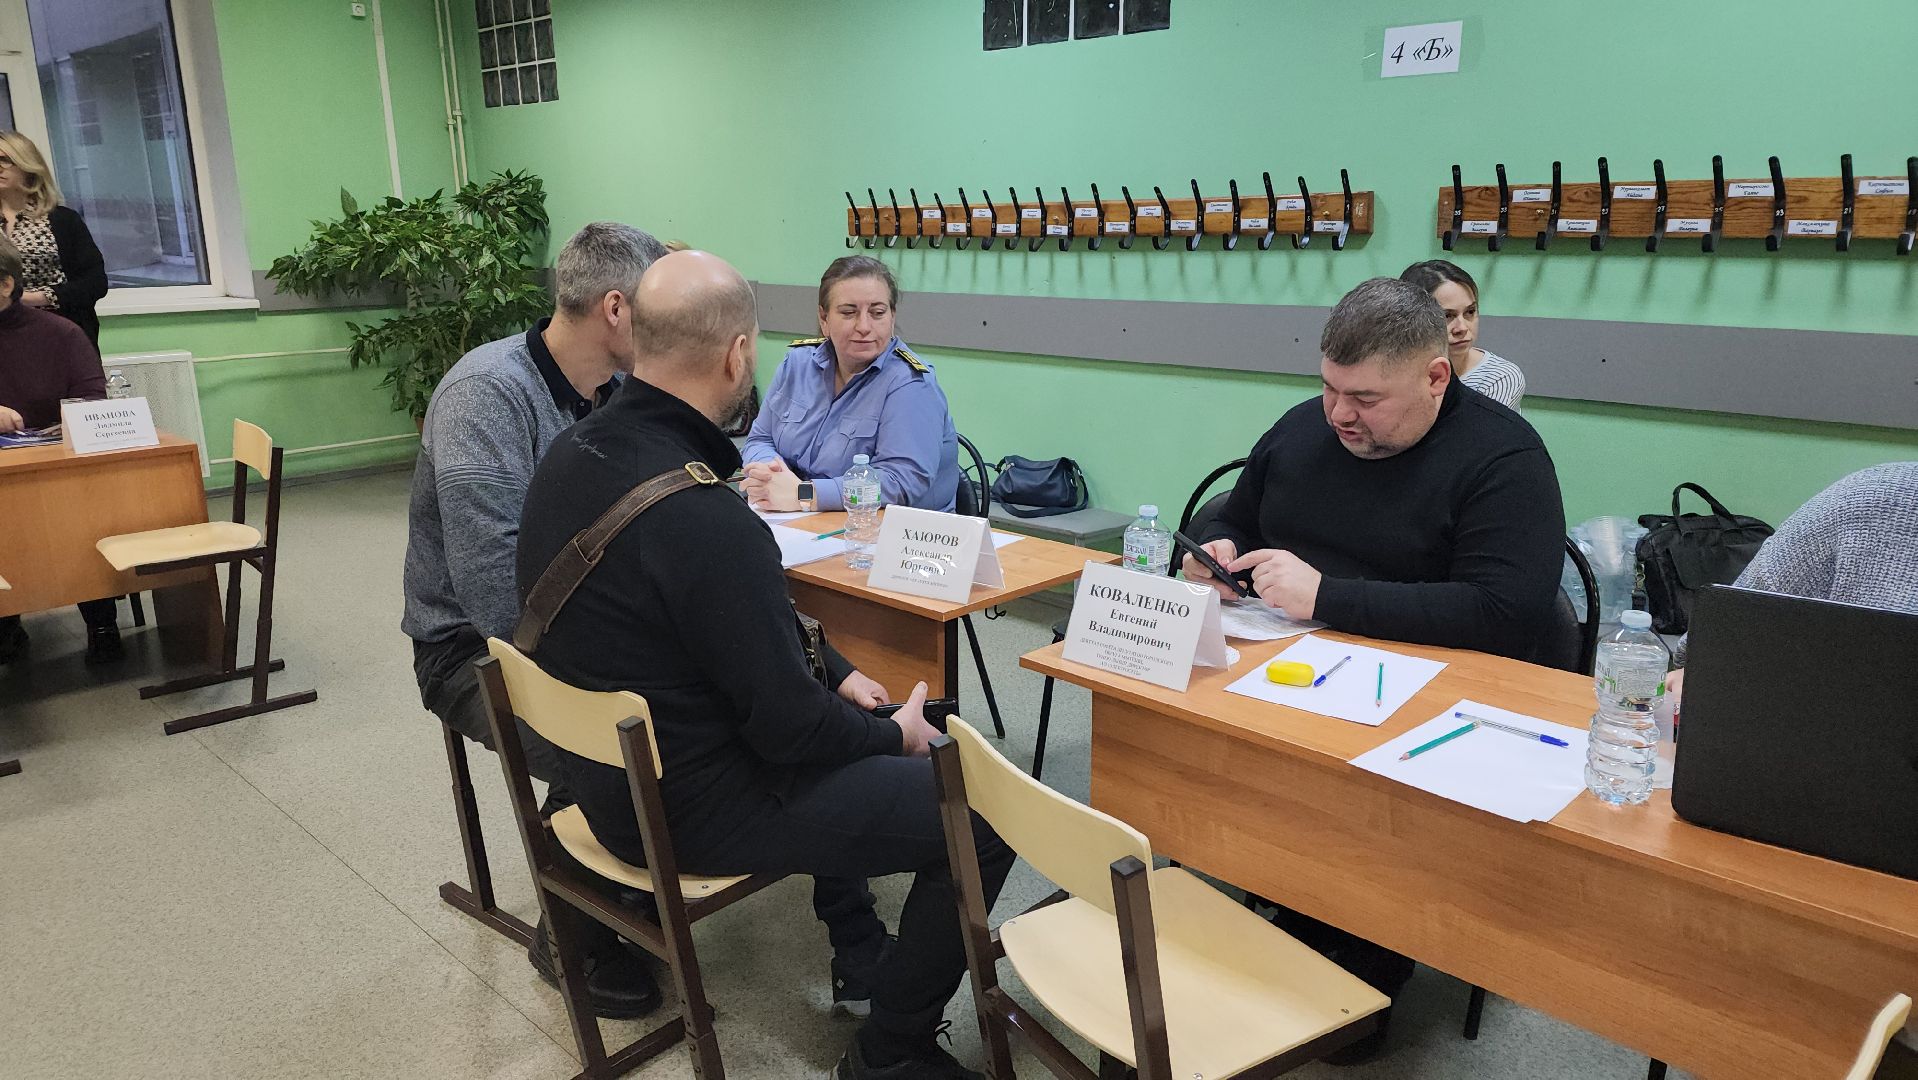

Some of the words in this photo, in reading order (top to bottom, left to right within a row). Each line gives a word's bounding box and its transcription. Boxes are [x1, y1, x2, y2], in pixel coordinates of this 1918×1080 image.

[1391, 40, 1405, 64] 4
[1412, 37, 1453, 61] «Б»
[84, 410, 136, 421] ИВАНОВА
[94, 421, 132, 430] Людмила
[95, 429, 136, 439] Сергеевна
[902, 528, 959, 547] ХАЮРОВ
[1089, 583, 1191, 619] КОВАЛЕНКО
[1110, 608, 1158, 630] Евгений
[1088, 620, 1172, 651] Владимирович
